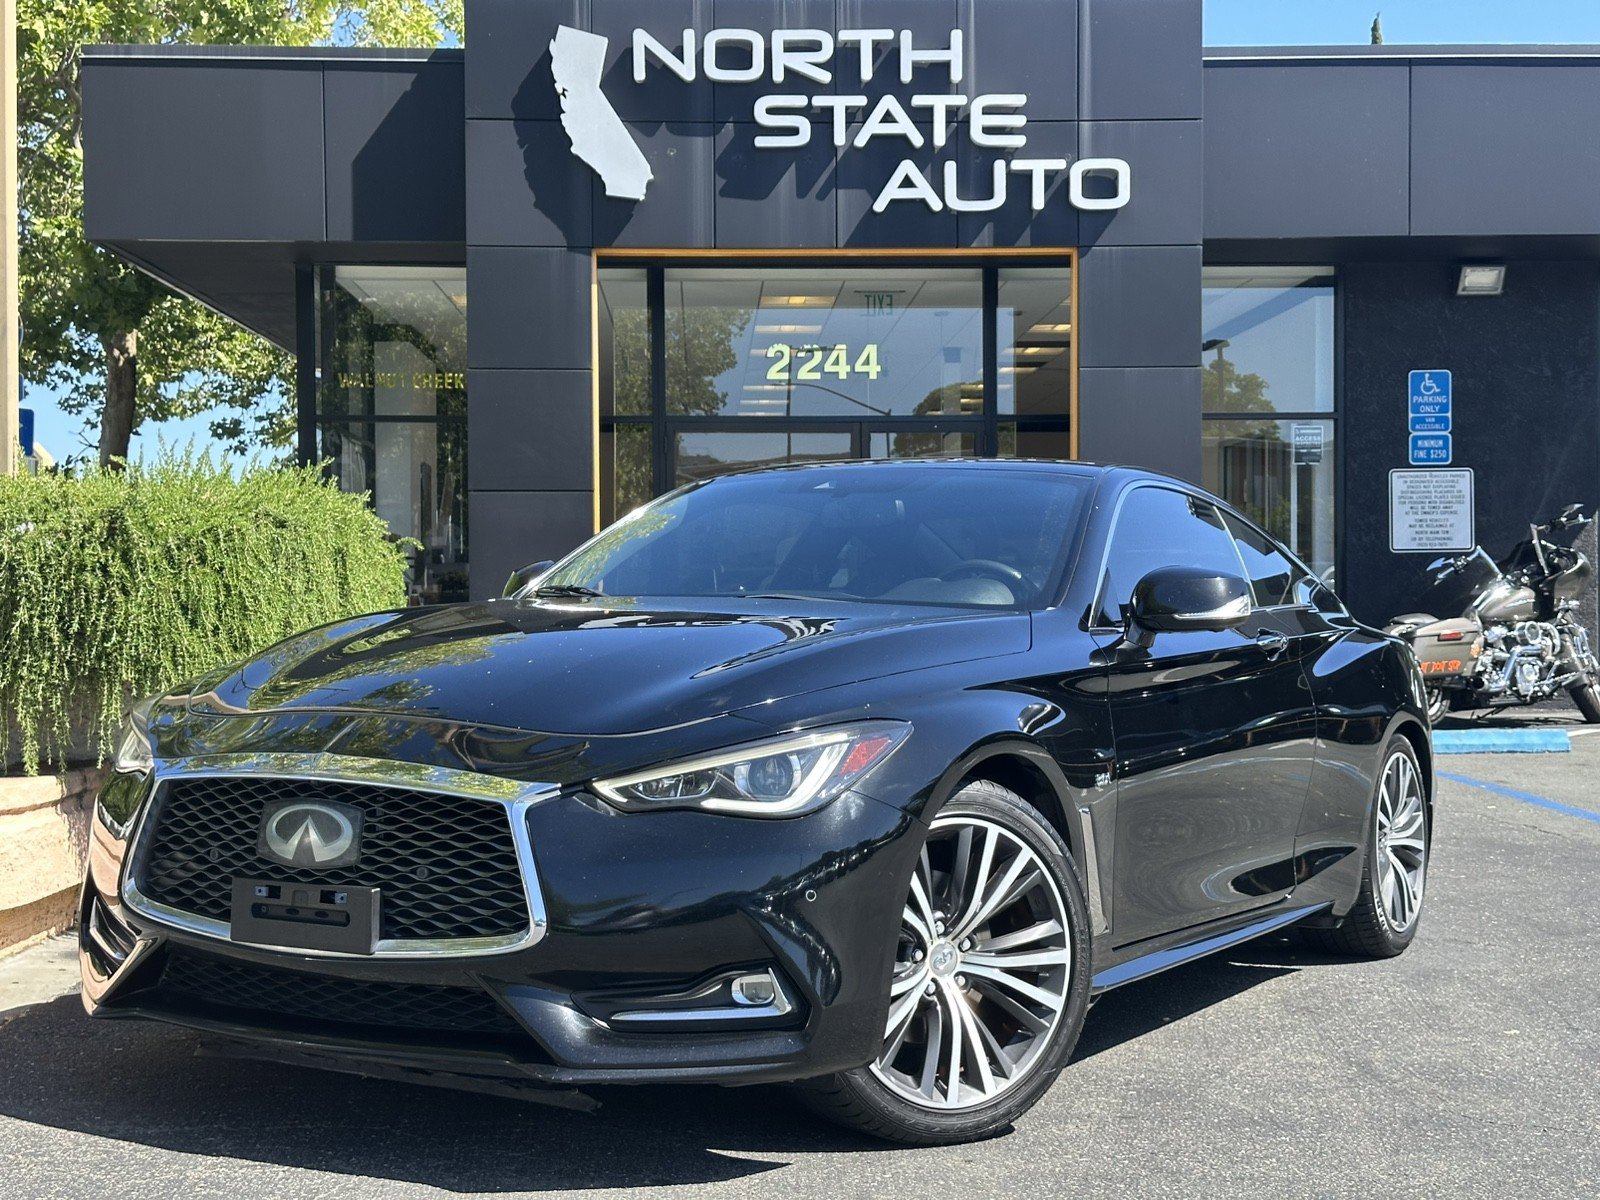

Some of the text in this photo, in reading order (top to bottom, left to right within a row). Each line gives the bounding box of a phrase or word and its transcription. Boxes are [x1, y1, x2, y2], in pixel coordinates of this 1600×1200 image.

[632, 28, 964, 85] NORTH
[754, 94, 1028, 149] STATE
[872, 158, 1132, 213] AUTO
[766, 343, 882, 380] 2244
[412, 372, 465, 389] CREEK
[1412, 395, 1448, 403] PARKING
[1419, 405, 1440, 413] ONLY
[1417, 439, 1444, 448] MINIMUM
[1413, 449, 1447, 459] FINE $250
